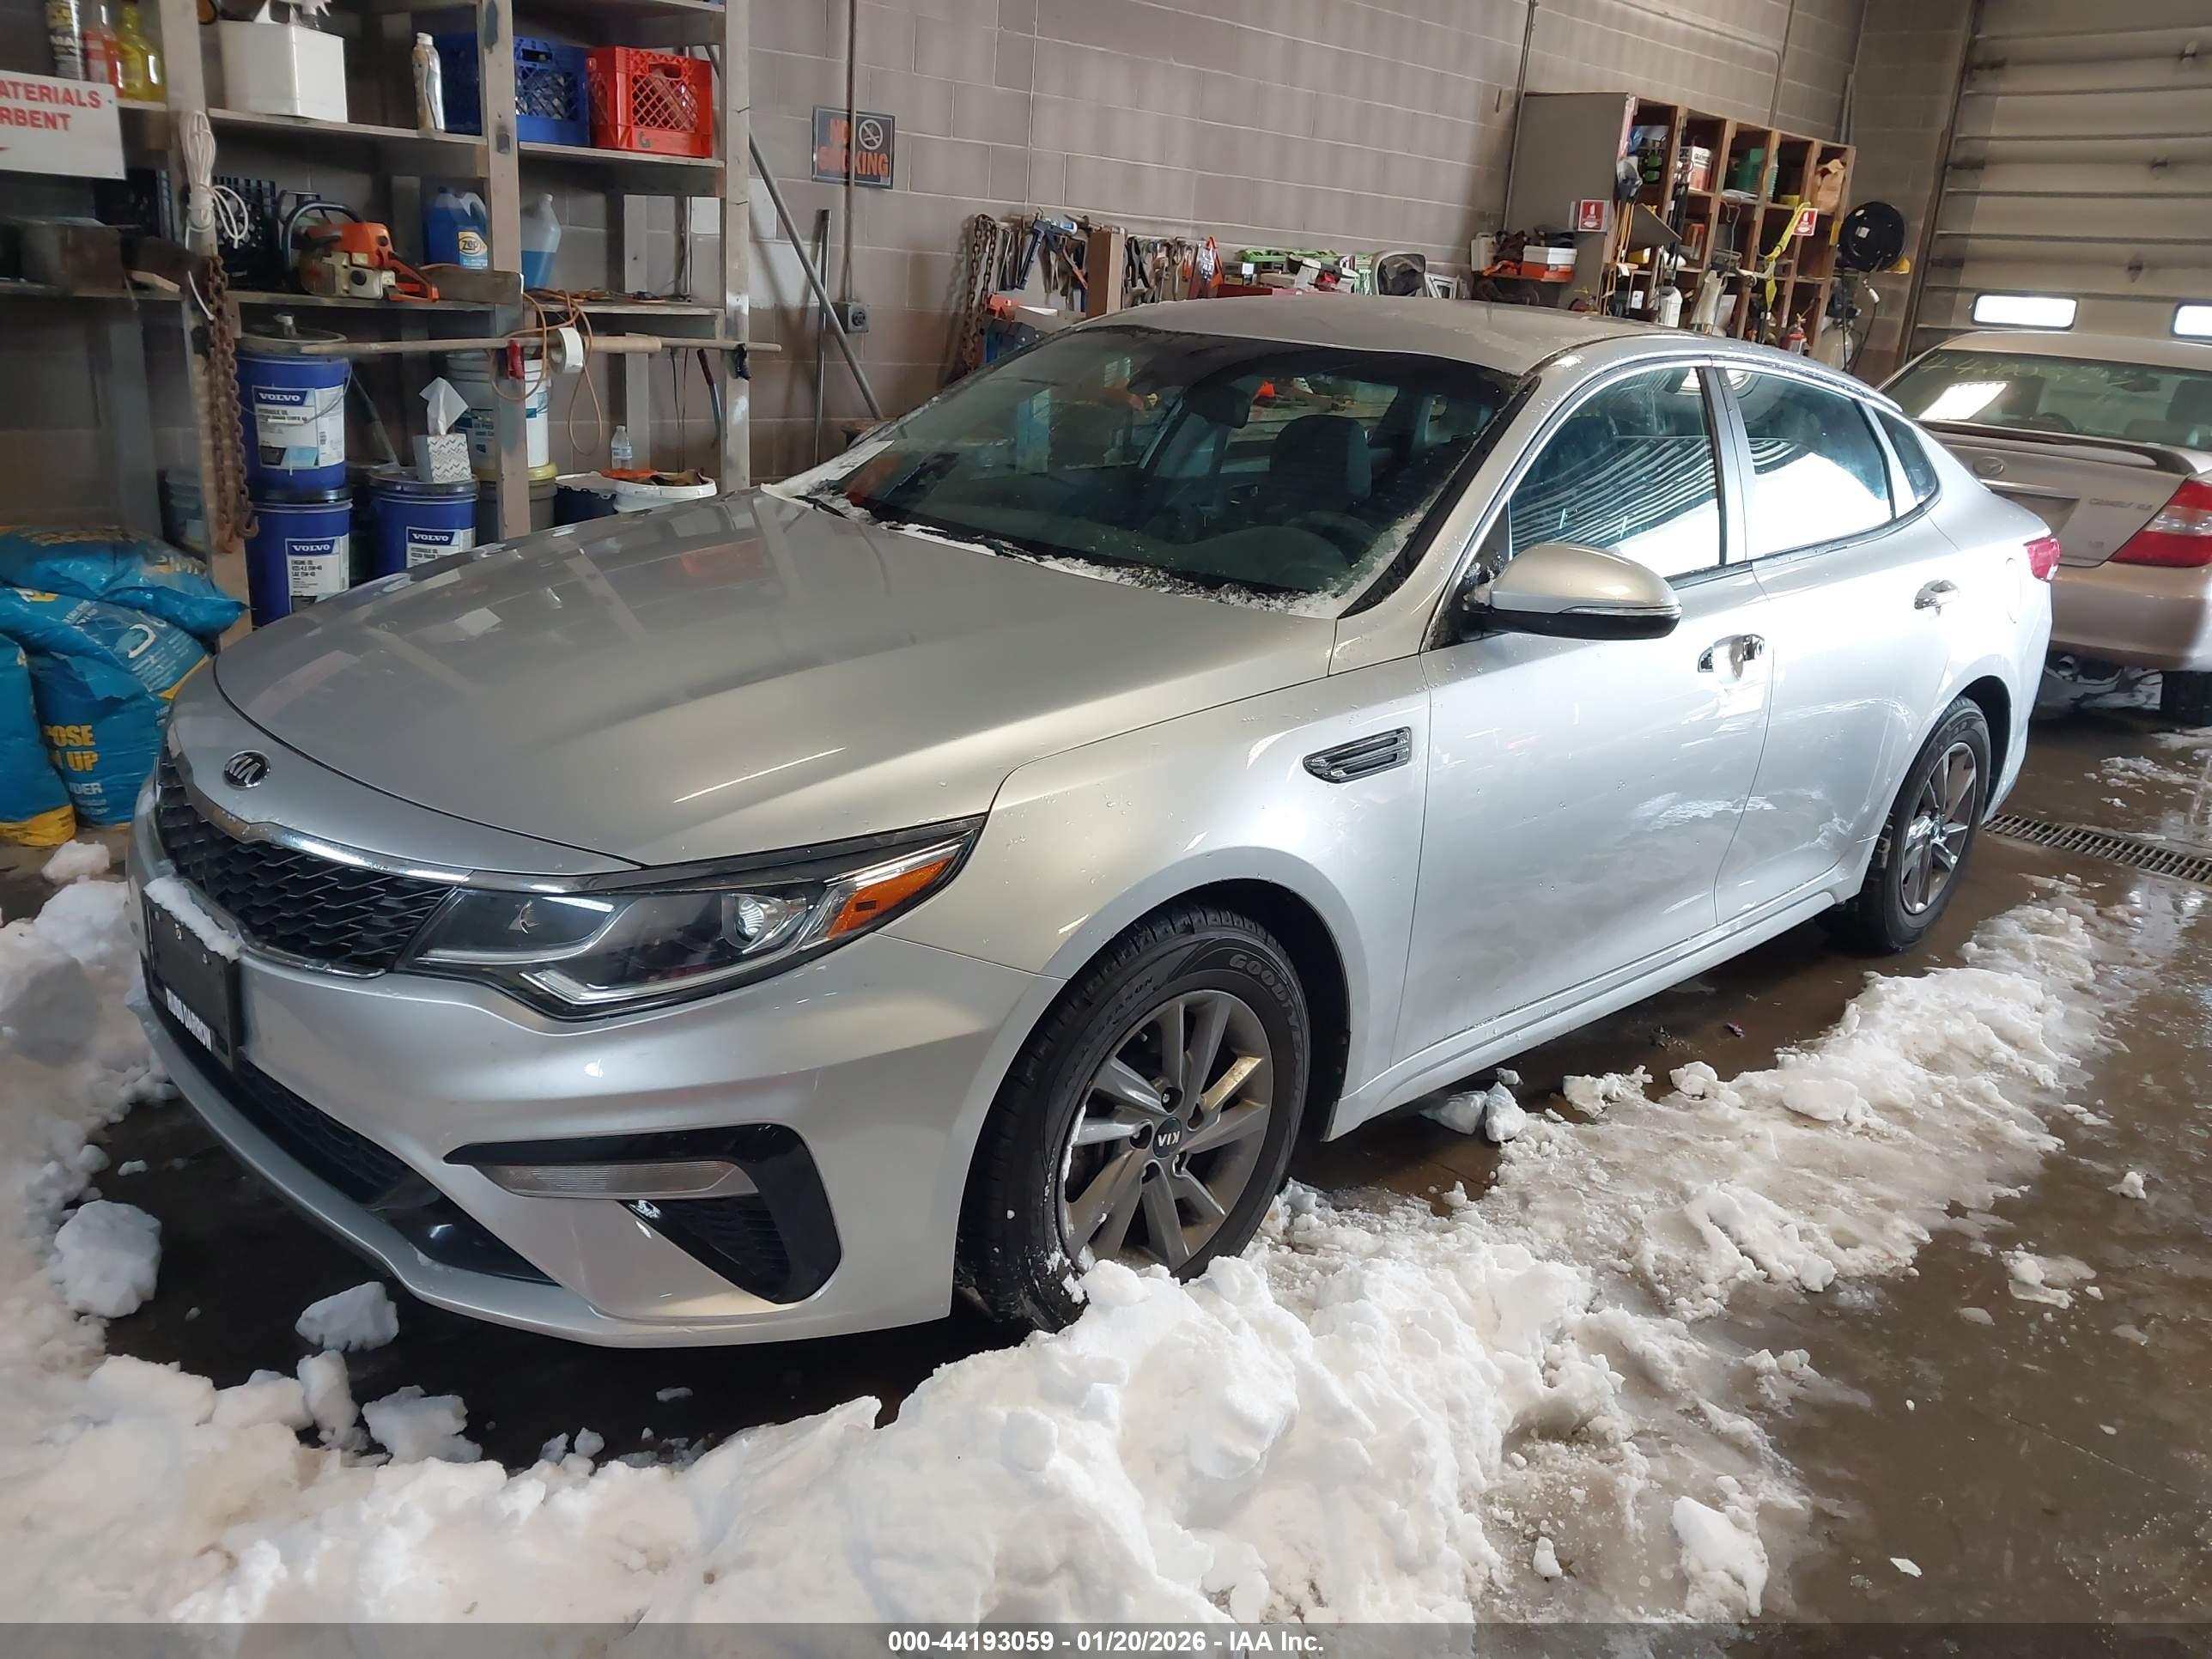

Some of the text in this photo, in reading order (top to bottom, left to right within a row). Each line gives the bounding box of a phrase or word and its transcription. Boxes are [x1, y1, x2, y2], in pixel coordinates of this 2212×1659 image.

[0, 81, 101, 109] ATERIALS
[0, 106, 71, 131] RBENT
[258, 392, 301, 402] VOLVO
[412, 532, 449, 542] VOLVO
[292, 544, 331, 552] VOLVO
[66, 750, 99, 772] UP
[226, 756, 261, 784] KIA
[1158, 1130, 1181, 1147] KIA
